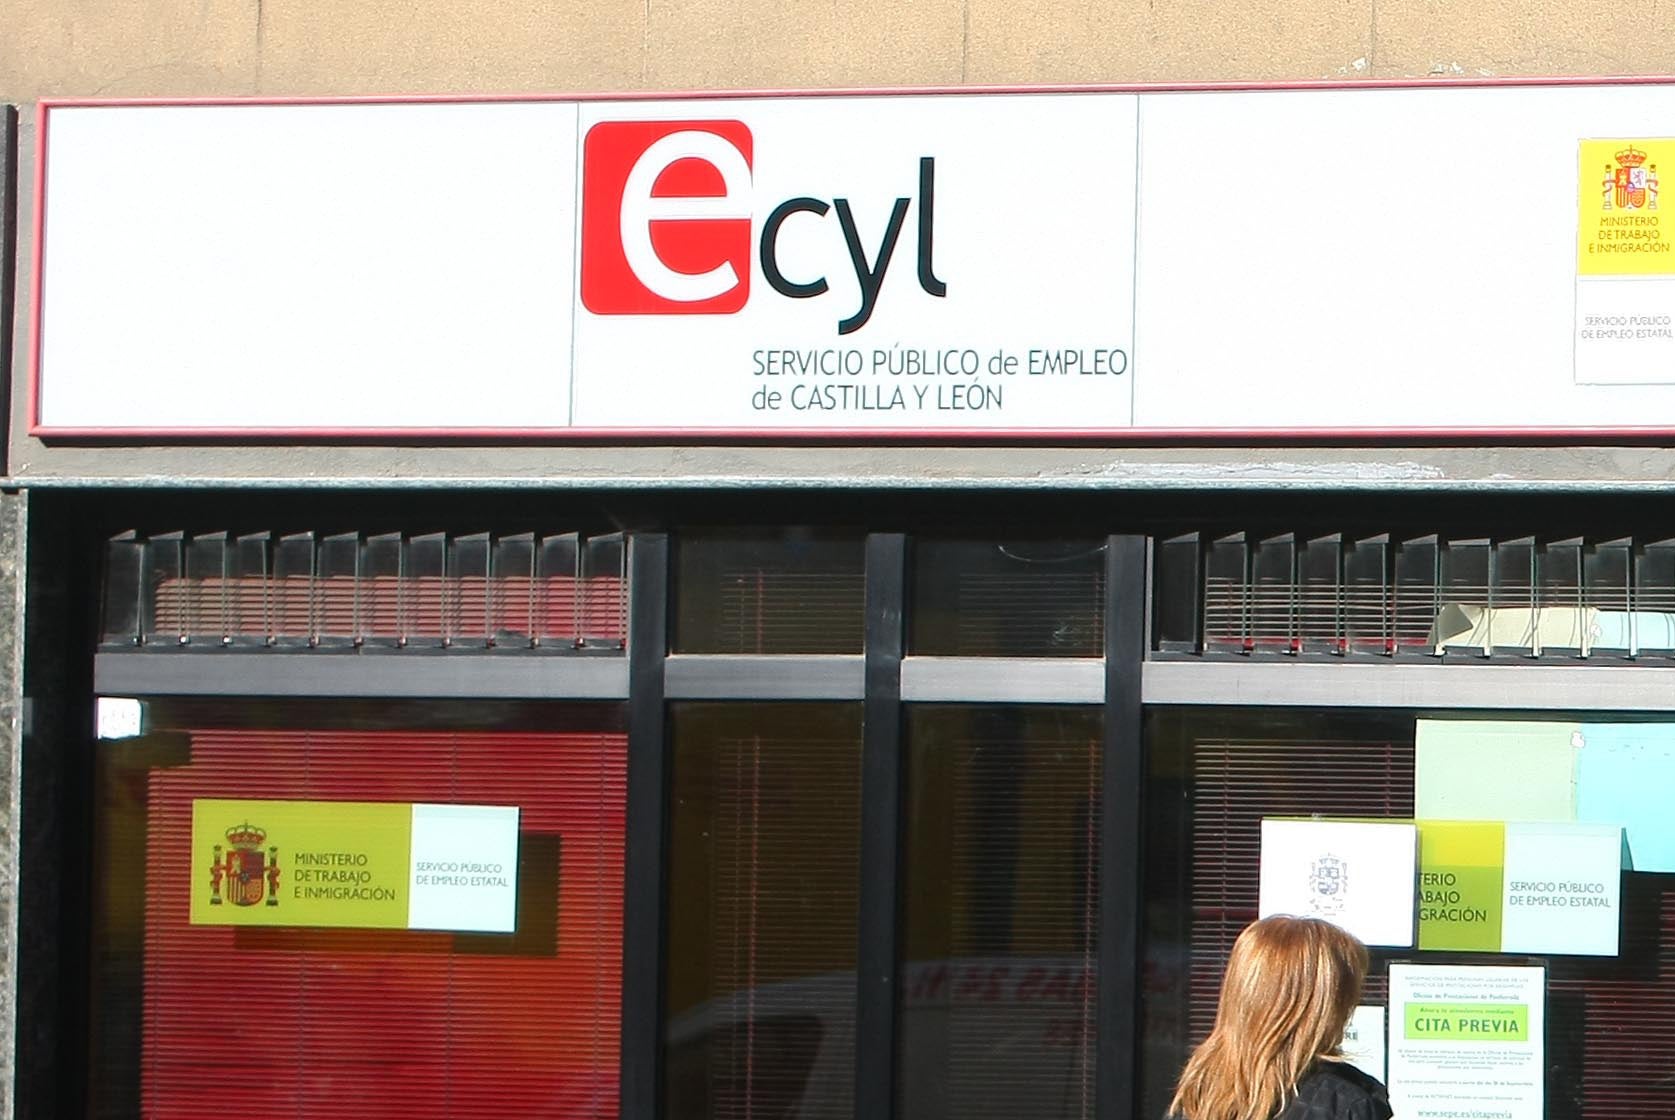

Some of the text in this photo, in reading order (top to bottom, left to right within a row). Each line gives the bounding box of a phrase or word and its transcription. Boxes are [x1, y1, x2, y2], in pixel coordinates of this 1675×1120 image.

[1599, 216, 1660, 227] MINISTERIO
[1597, 229, 1661, 242] DE TRABAJO
[1588, 241, 1671, 254] E INMIGRACIÓN
[751, 344, 1128, 377] SERVICIO PÚBLICO de EMPLEO
[750, 378, 1003, 411] de CASTILLA Y LEÓN
[294, 852, 368, 867] MINISTERIO
[415, 860, 503, 874] SERVICIO PÚBLICO
[294, 870, 372, 886] DE TRABAJO
[415, 874, 509, 888] DE EMPLEO ESTATAL
[1417, 872, 1457, 887] TERIO
[294, 885, 396, 901] E INMIGRACIÓN
[1509, 879, 1605, 894] SERVICIO PÚBLICO
[1417, 890, 1461, 907] ABAJO
[1509, 895, 1611, 909] DE EMPLEO ESTATAL
[1417, 906, 1488, 922] GRACIÓN
[1414, 1018, 1520, 1033] CITA PREVIA
